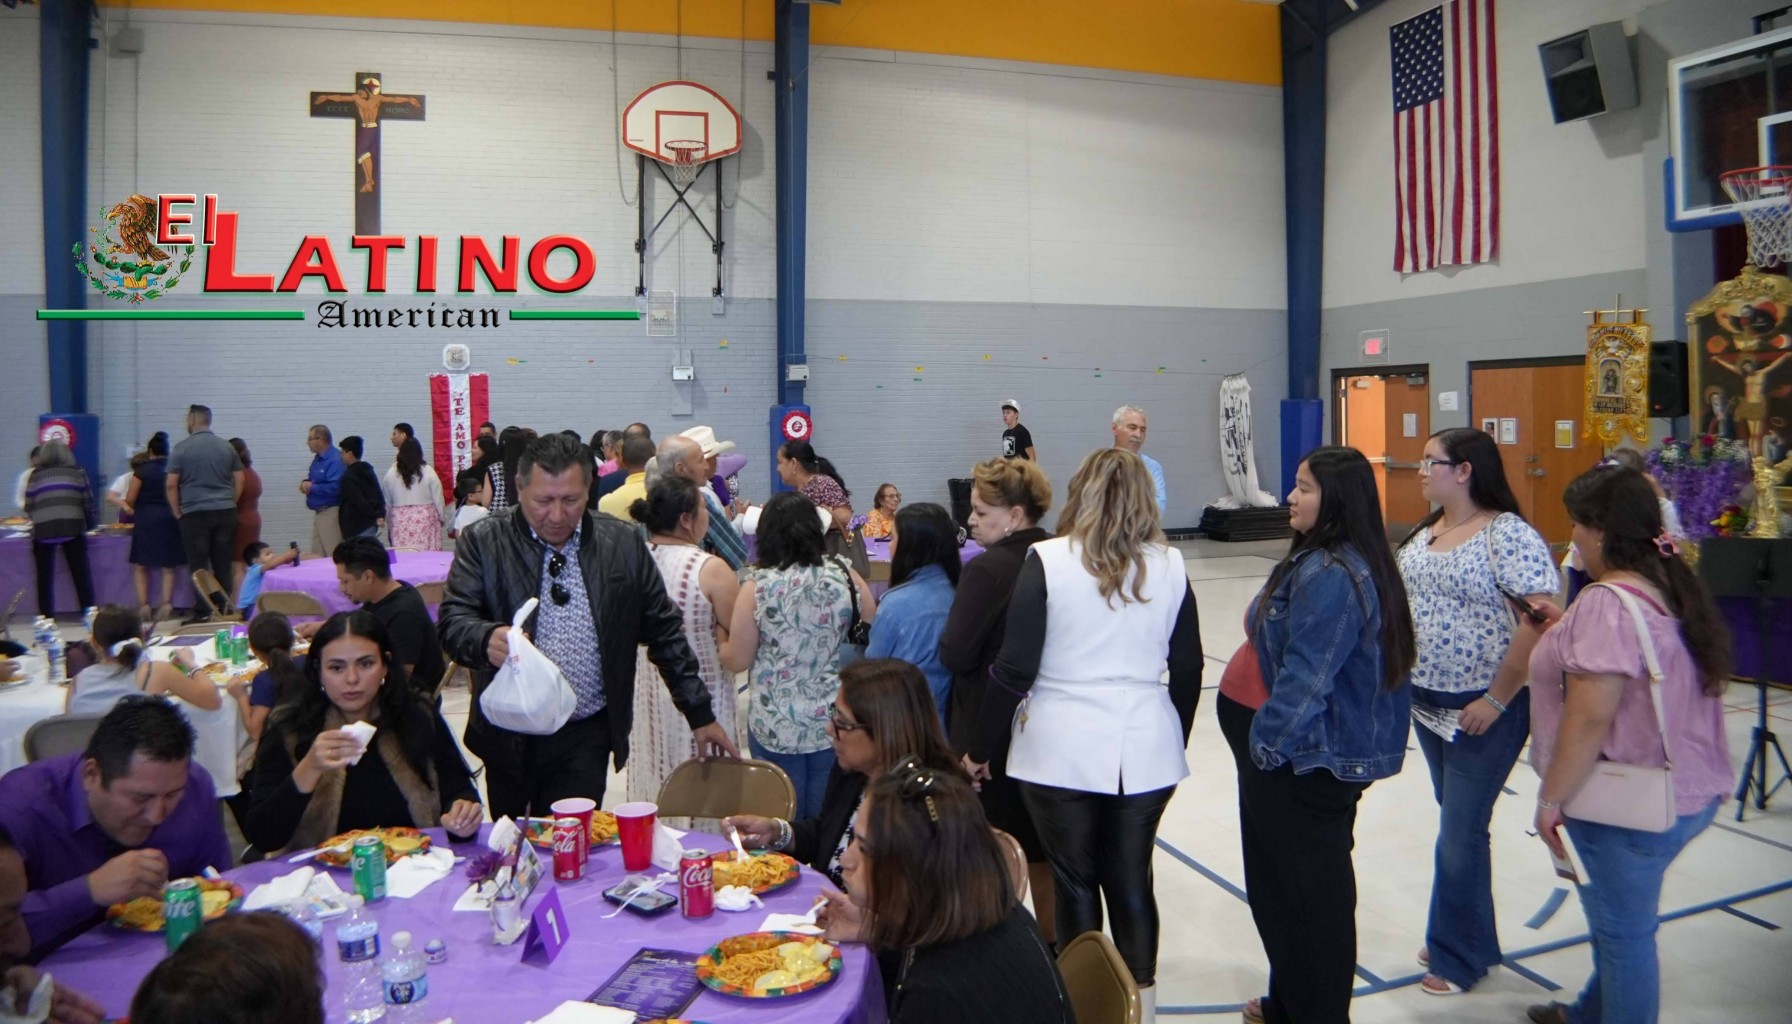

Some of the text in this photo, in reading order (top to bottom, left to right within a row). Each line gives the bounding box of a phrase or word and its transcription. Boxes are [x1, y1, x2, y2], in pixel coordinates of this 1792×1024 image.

[453, 398, 465, 416] TE
[455, 423, 466, 449] AMO
[546, 907, 561, 945] 1
